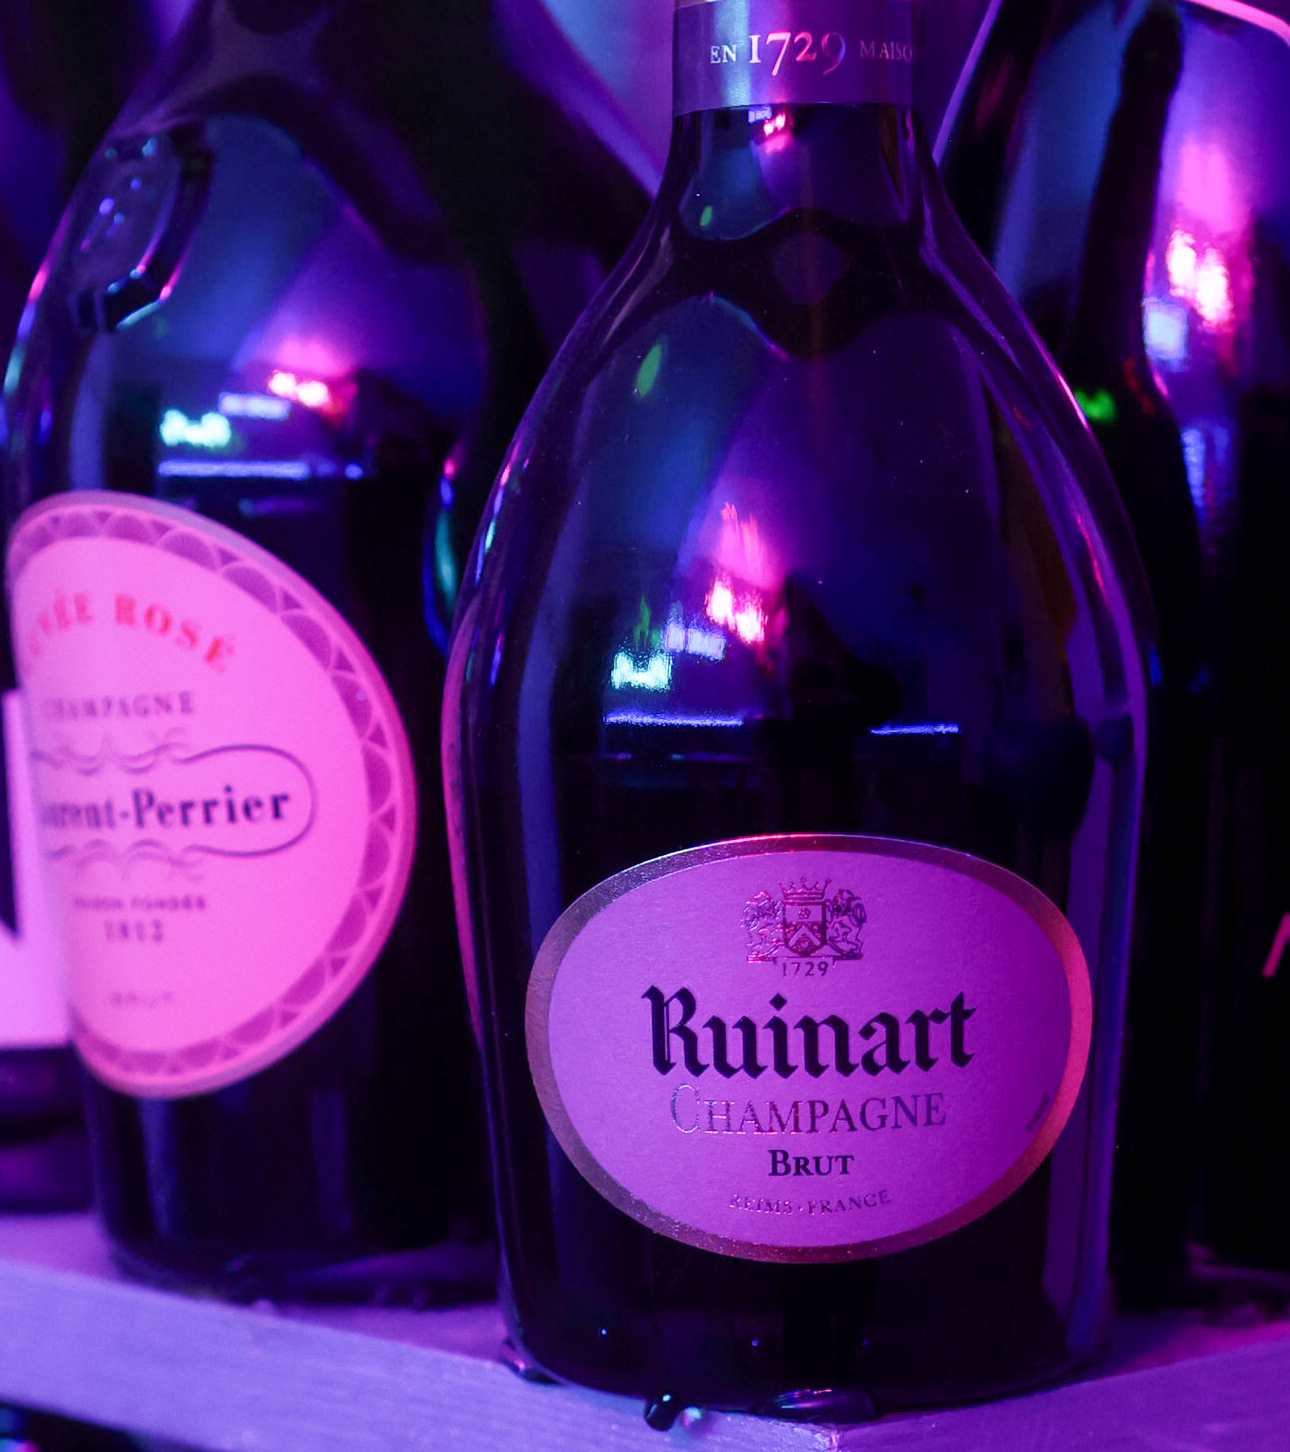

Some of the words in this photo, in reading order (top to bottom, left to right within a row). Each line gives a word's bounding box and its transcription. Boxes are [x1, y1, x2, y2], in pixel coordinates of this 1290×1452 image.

[710, 44, 737, 64] EN
[749, 31, 846, 77] 1729
[782, 961, 828, 977] 1729
[641, 984, 977, 1080] Ruinart
[670, 1083, 947, 1135] CHAMPAGNE
[768, 1149, 854, 1176] BRUT
[730, 1194, 793, 1215] REIMS
[808, 1189, 891, 1215] FRANCE
